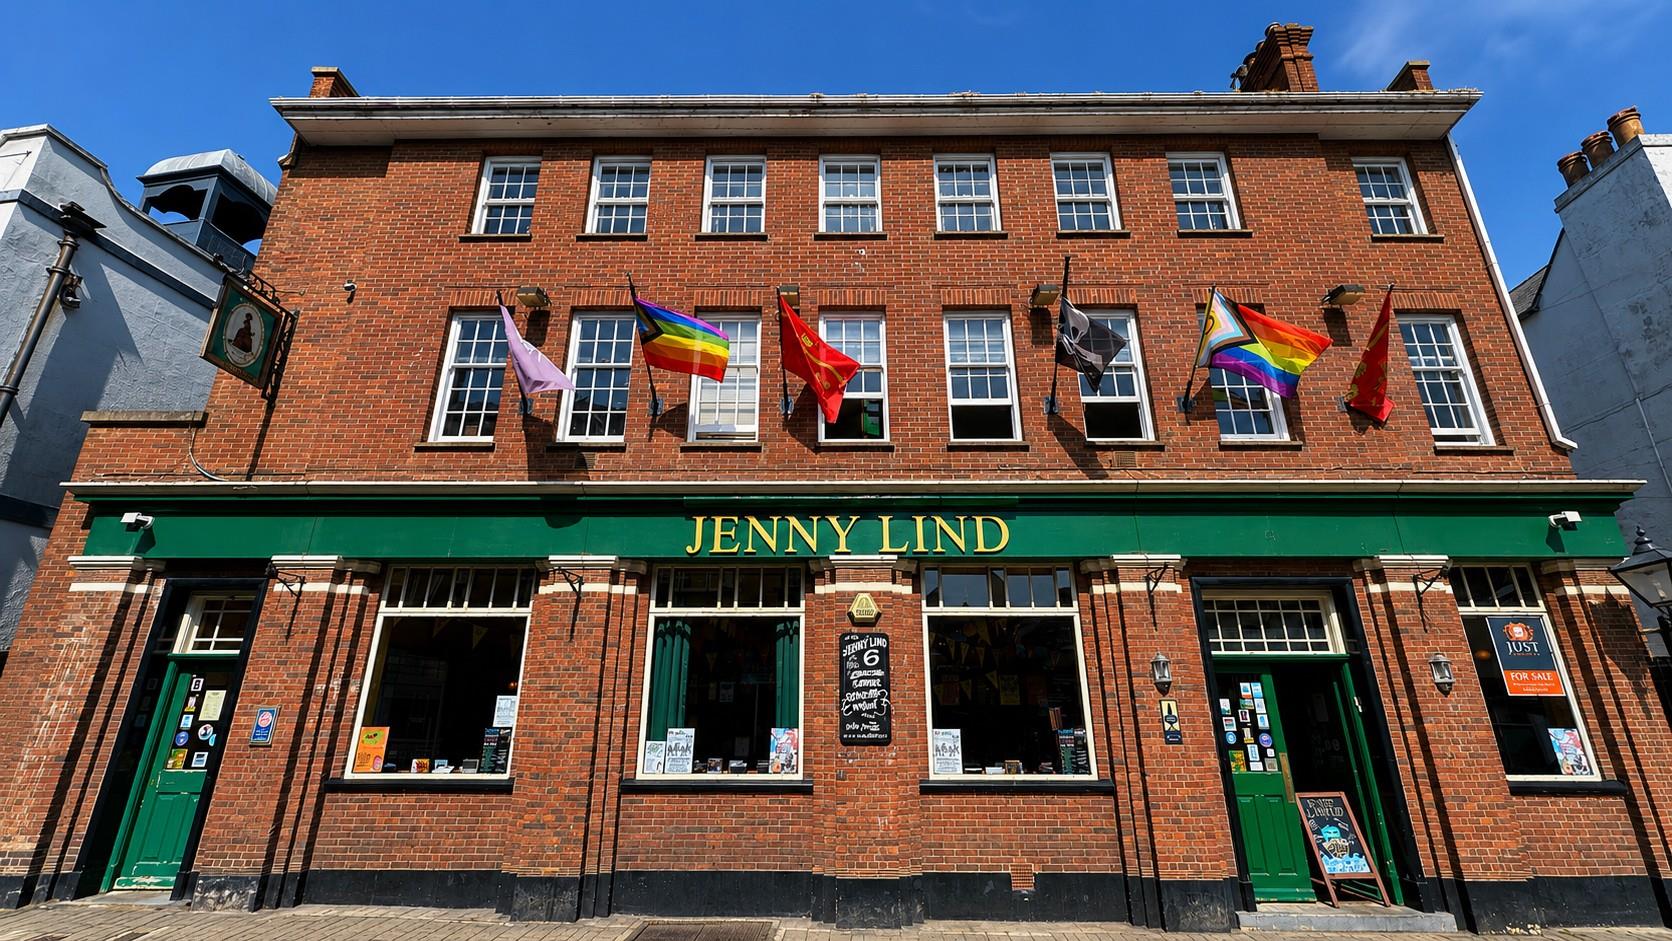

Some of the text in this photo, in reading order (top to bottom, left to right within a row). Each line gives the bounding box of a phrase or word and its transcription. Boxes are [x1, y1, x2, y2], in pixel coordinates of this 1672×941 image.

[686, 516, 1010, 555] JENNY LIND
[1506, 642, 1538, 655] JUST
[863, 649, 880, 666] 6
[1511, 672, 1553, 681] FOR SALE
